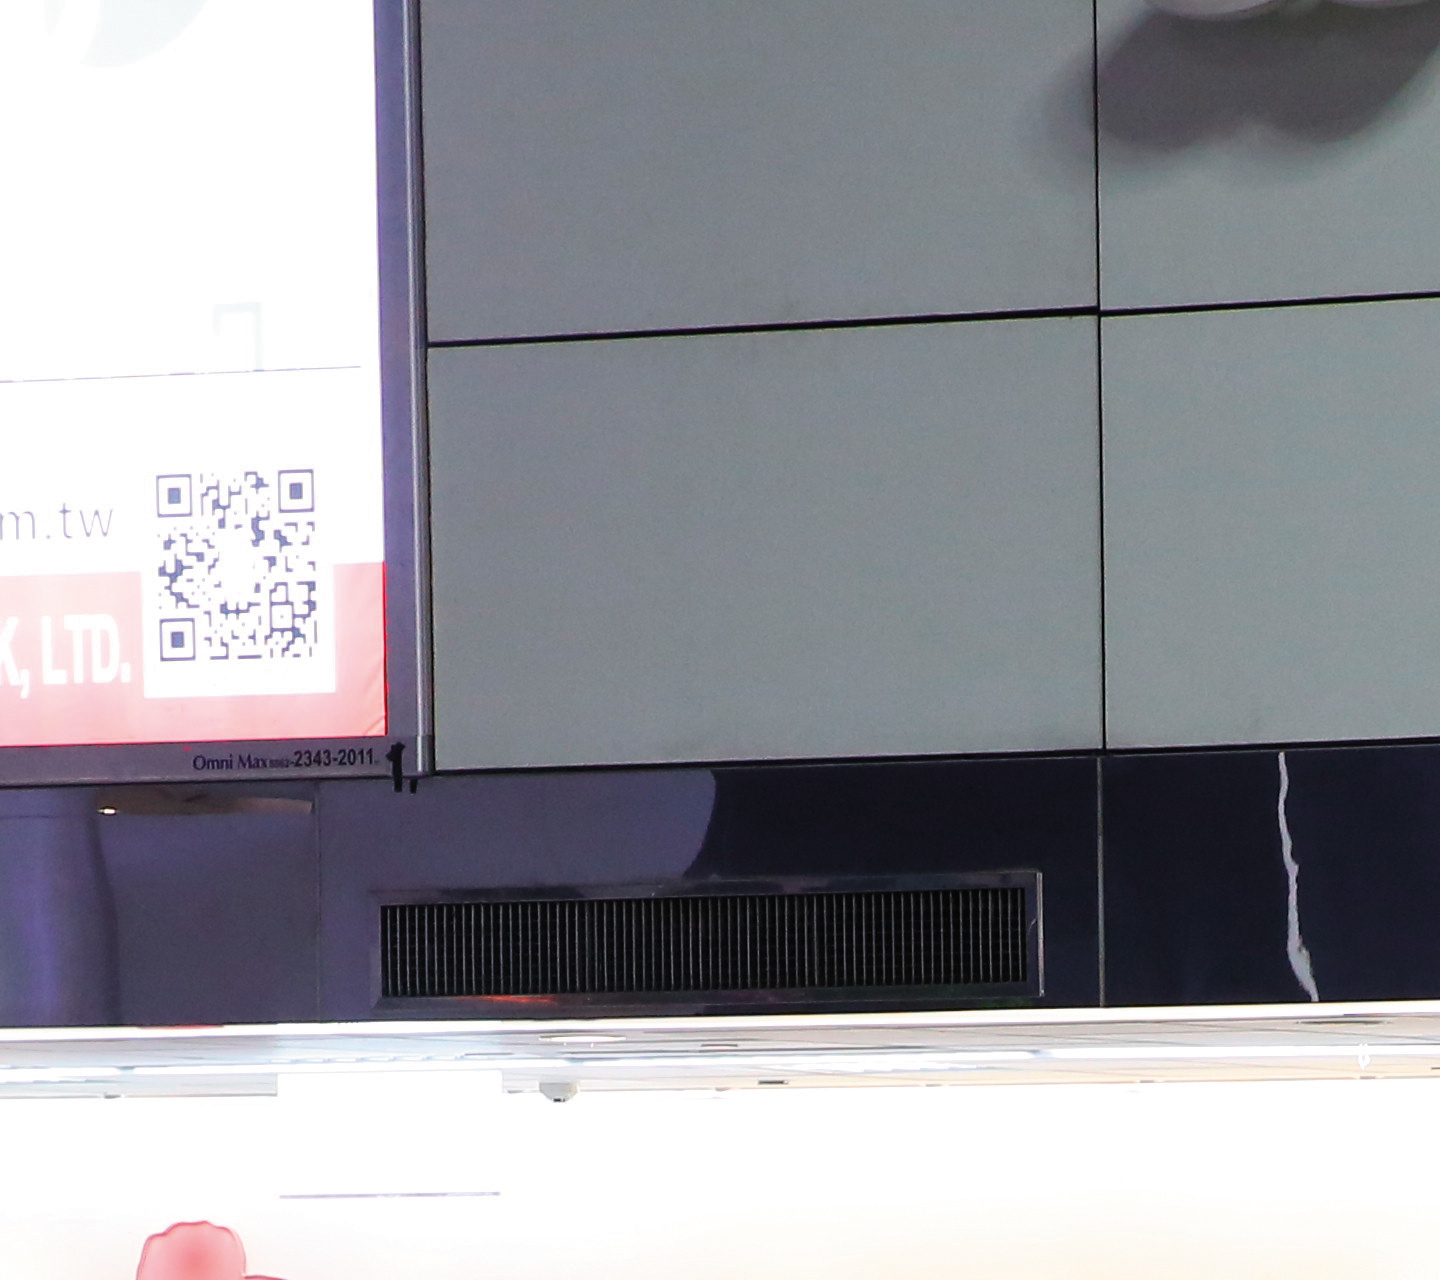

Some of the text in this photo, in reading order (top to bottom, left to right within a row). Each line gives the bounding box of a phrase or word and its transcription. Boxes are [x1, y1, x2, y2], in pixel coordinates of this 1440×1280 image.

[40, 613, 132, 685] LTD.
[192, 754, 234, 771] Omni
[237, 755, 268, 769] Max
